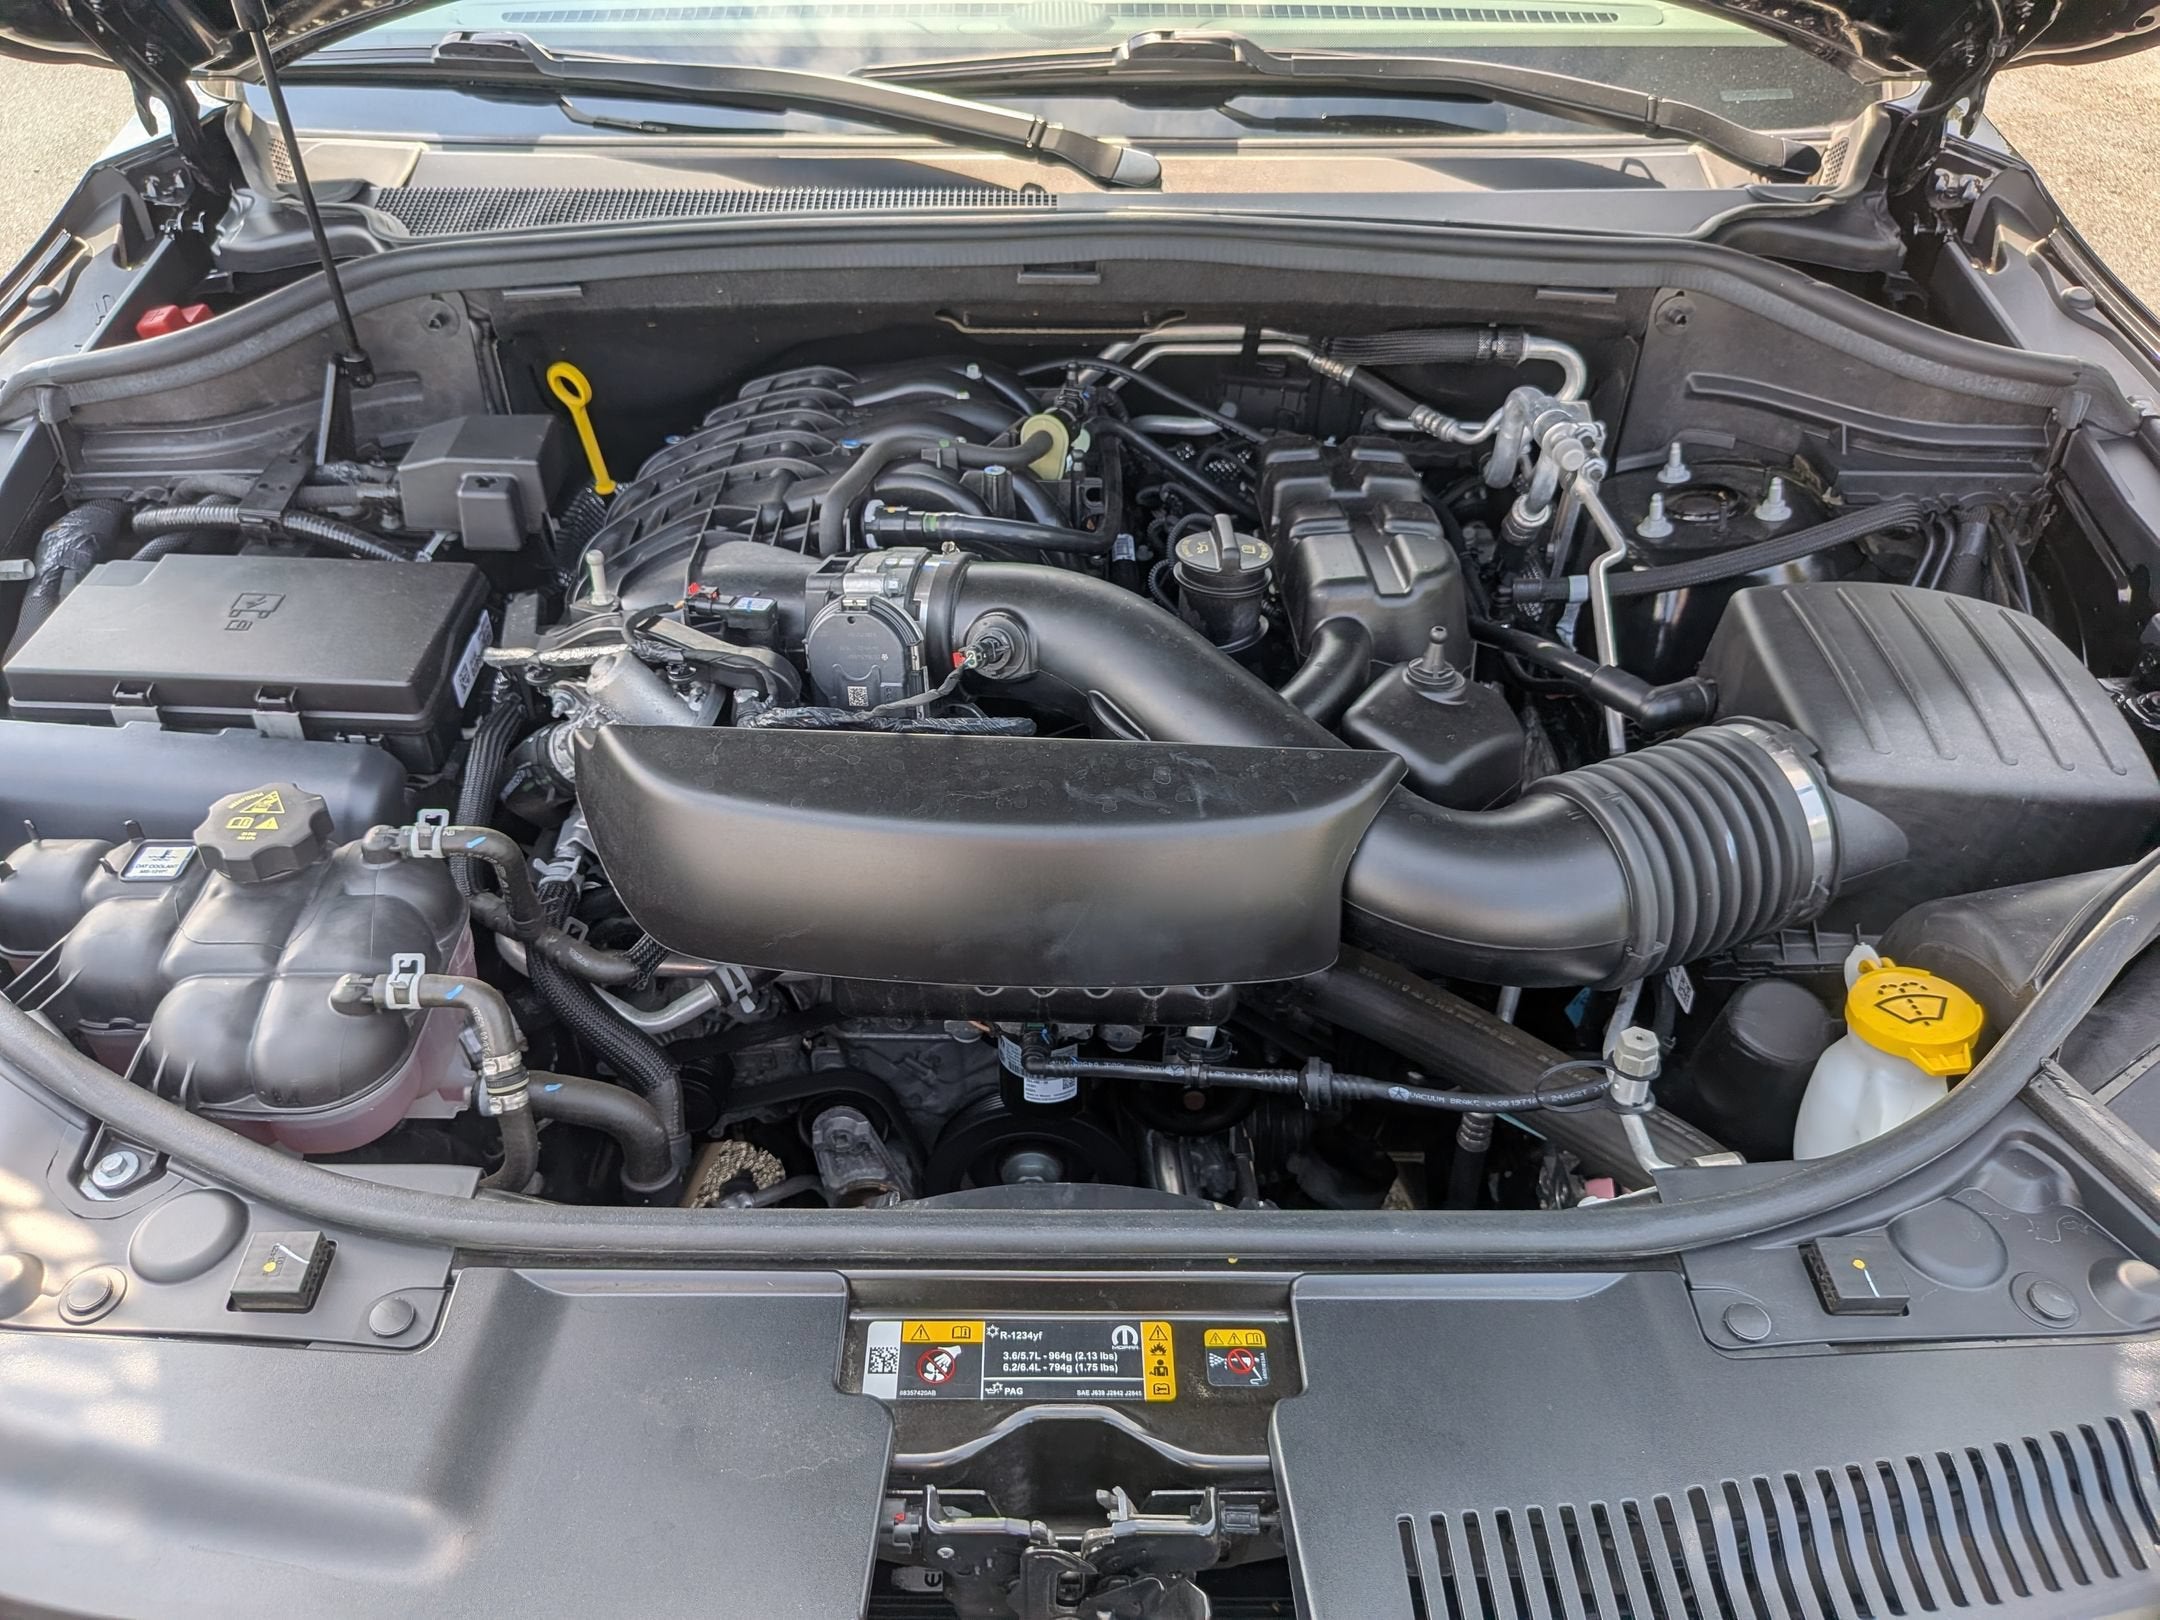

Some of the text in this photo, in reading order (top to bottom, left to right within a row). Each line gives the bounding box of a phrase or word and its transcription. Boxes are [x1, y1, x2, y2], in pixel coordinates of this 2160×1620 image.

[1409, 1091, 1445, 1103] VACUUM
[1449, 1097, 1480, 1107] BRAKE
[1000, 1331, 1043, 1342] R-1234yf
[1002, 1351, 1042, 1361] 3.6/5.7L
[1048, 1351, 1073, 1362] 964g
[1075, 1351, 1098, 1362] (2.13
[1099, 1351, 1118, 1362] lbs)
[1002, 1363, 1042, 1372] 6.2/6.4L
[1048, 1363, 1073, 1374] 794g
[1075, 1363, 1099, 1375] (1.75
[1099, 1363, 1119, 1375] lbs)
[1004, 1387, 1024, 1396] PAG
[1076, 1389, 1090, 1397] SAE
